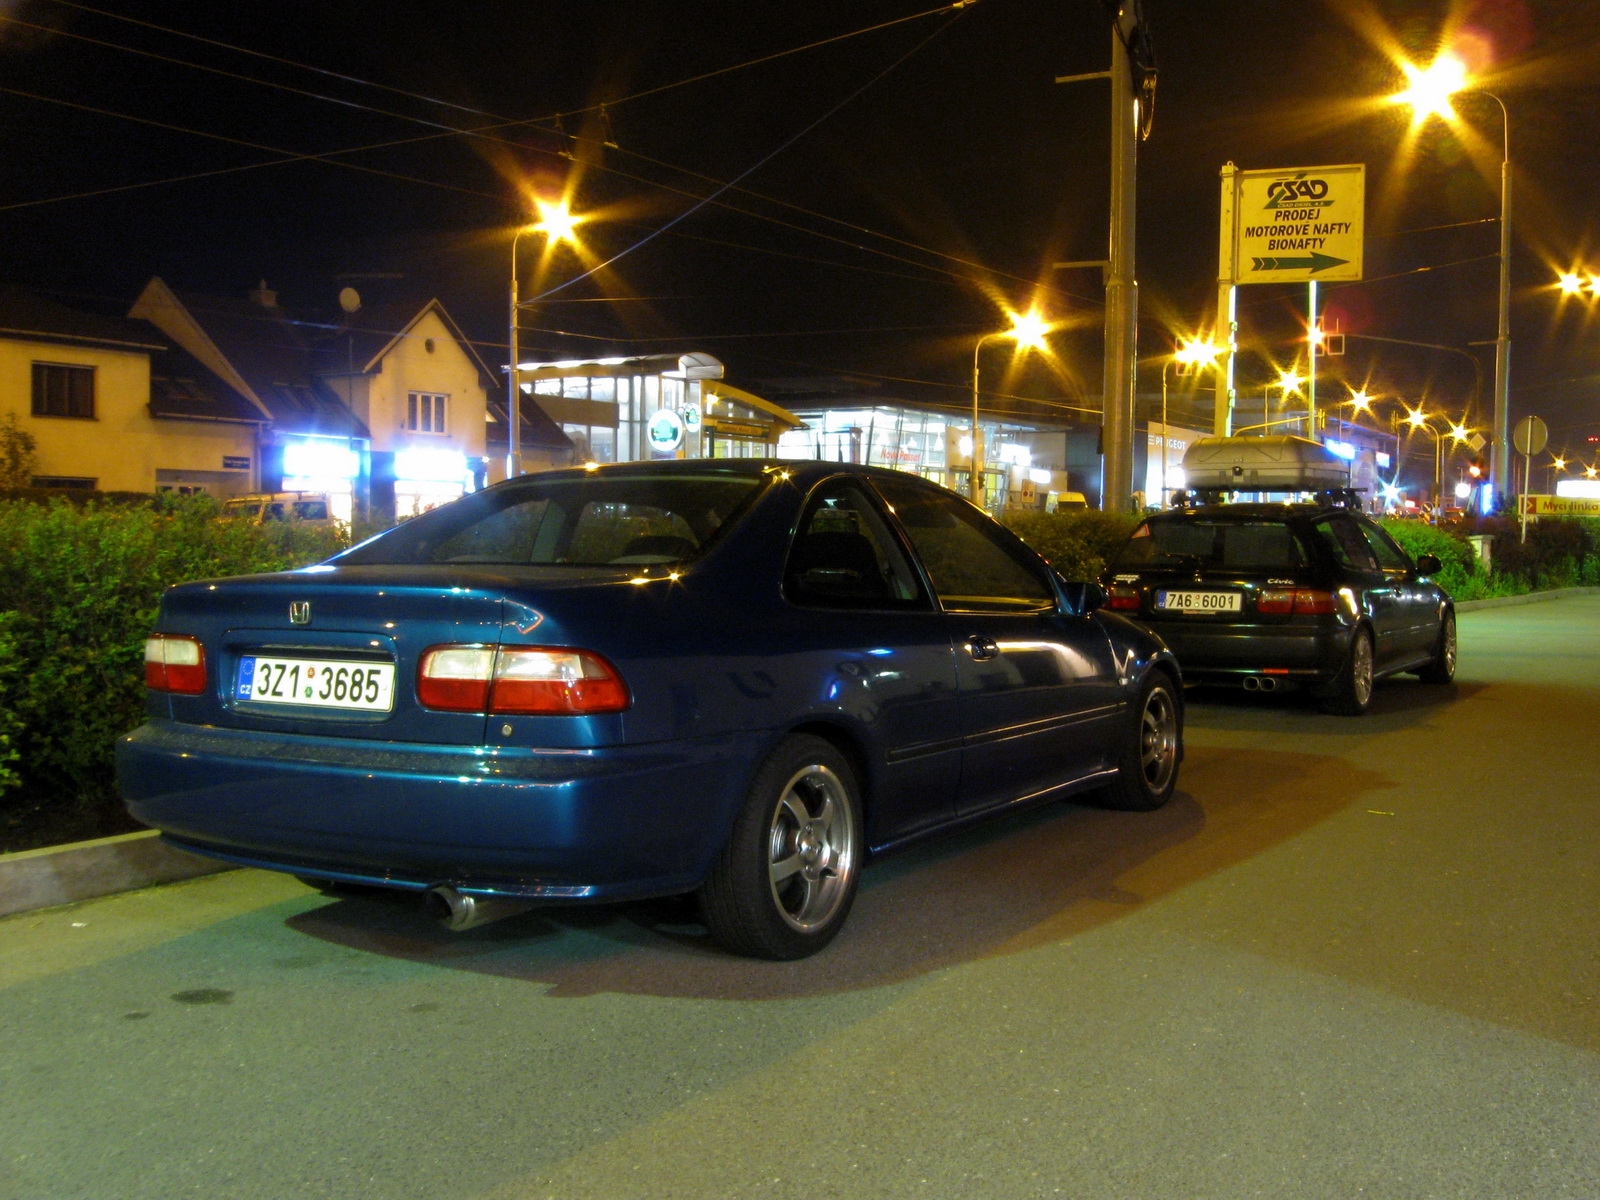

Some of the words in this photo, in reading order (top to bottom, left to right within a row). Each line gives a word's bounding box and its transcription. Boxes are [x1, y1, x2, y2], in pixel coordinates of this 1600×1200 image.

[1274, 209, 1320, 222] PRODEJ
[1245, 221, 1309, 238] MOTOROVÉ
[1313, 223, 1351, 235] NAFTY
[1268, 238, 1325, 250] BIONAFTY
[1168, 593, 1192, 608] 7A6
[1202, 594, 1233, 609] 6001
[240, 684, 251, 694] CZ
[257, 663, 300, 698] 3Z1
[318, 666, 381, 703] 3685
